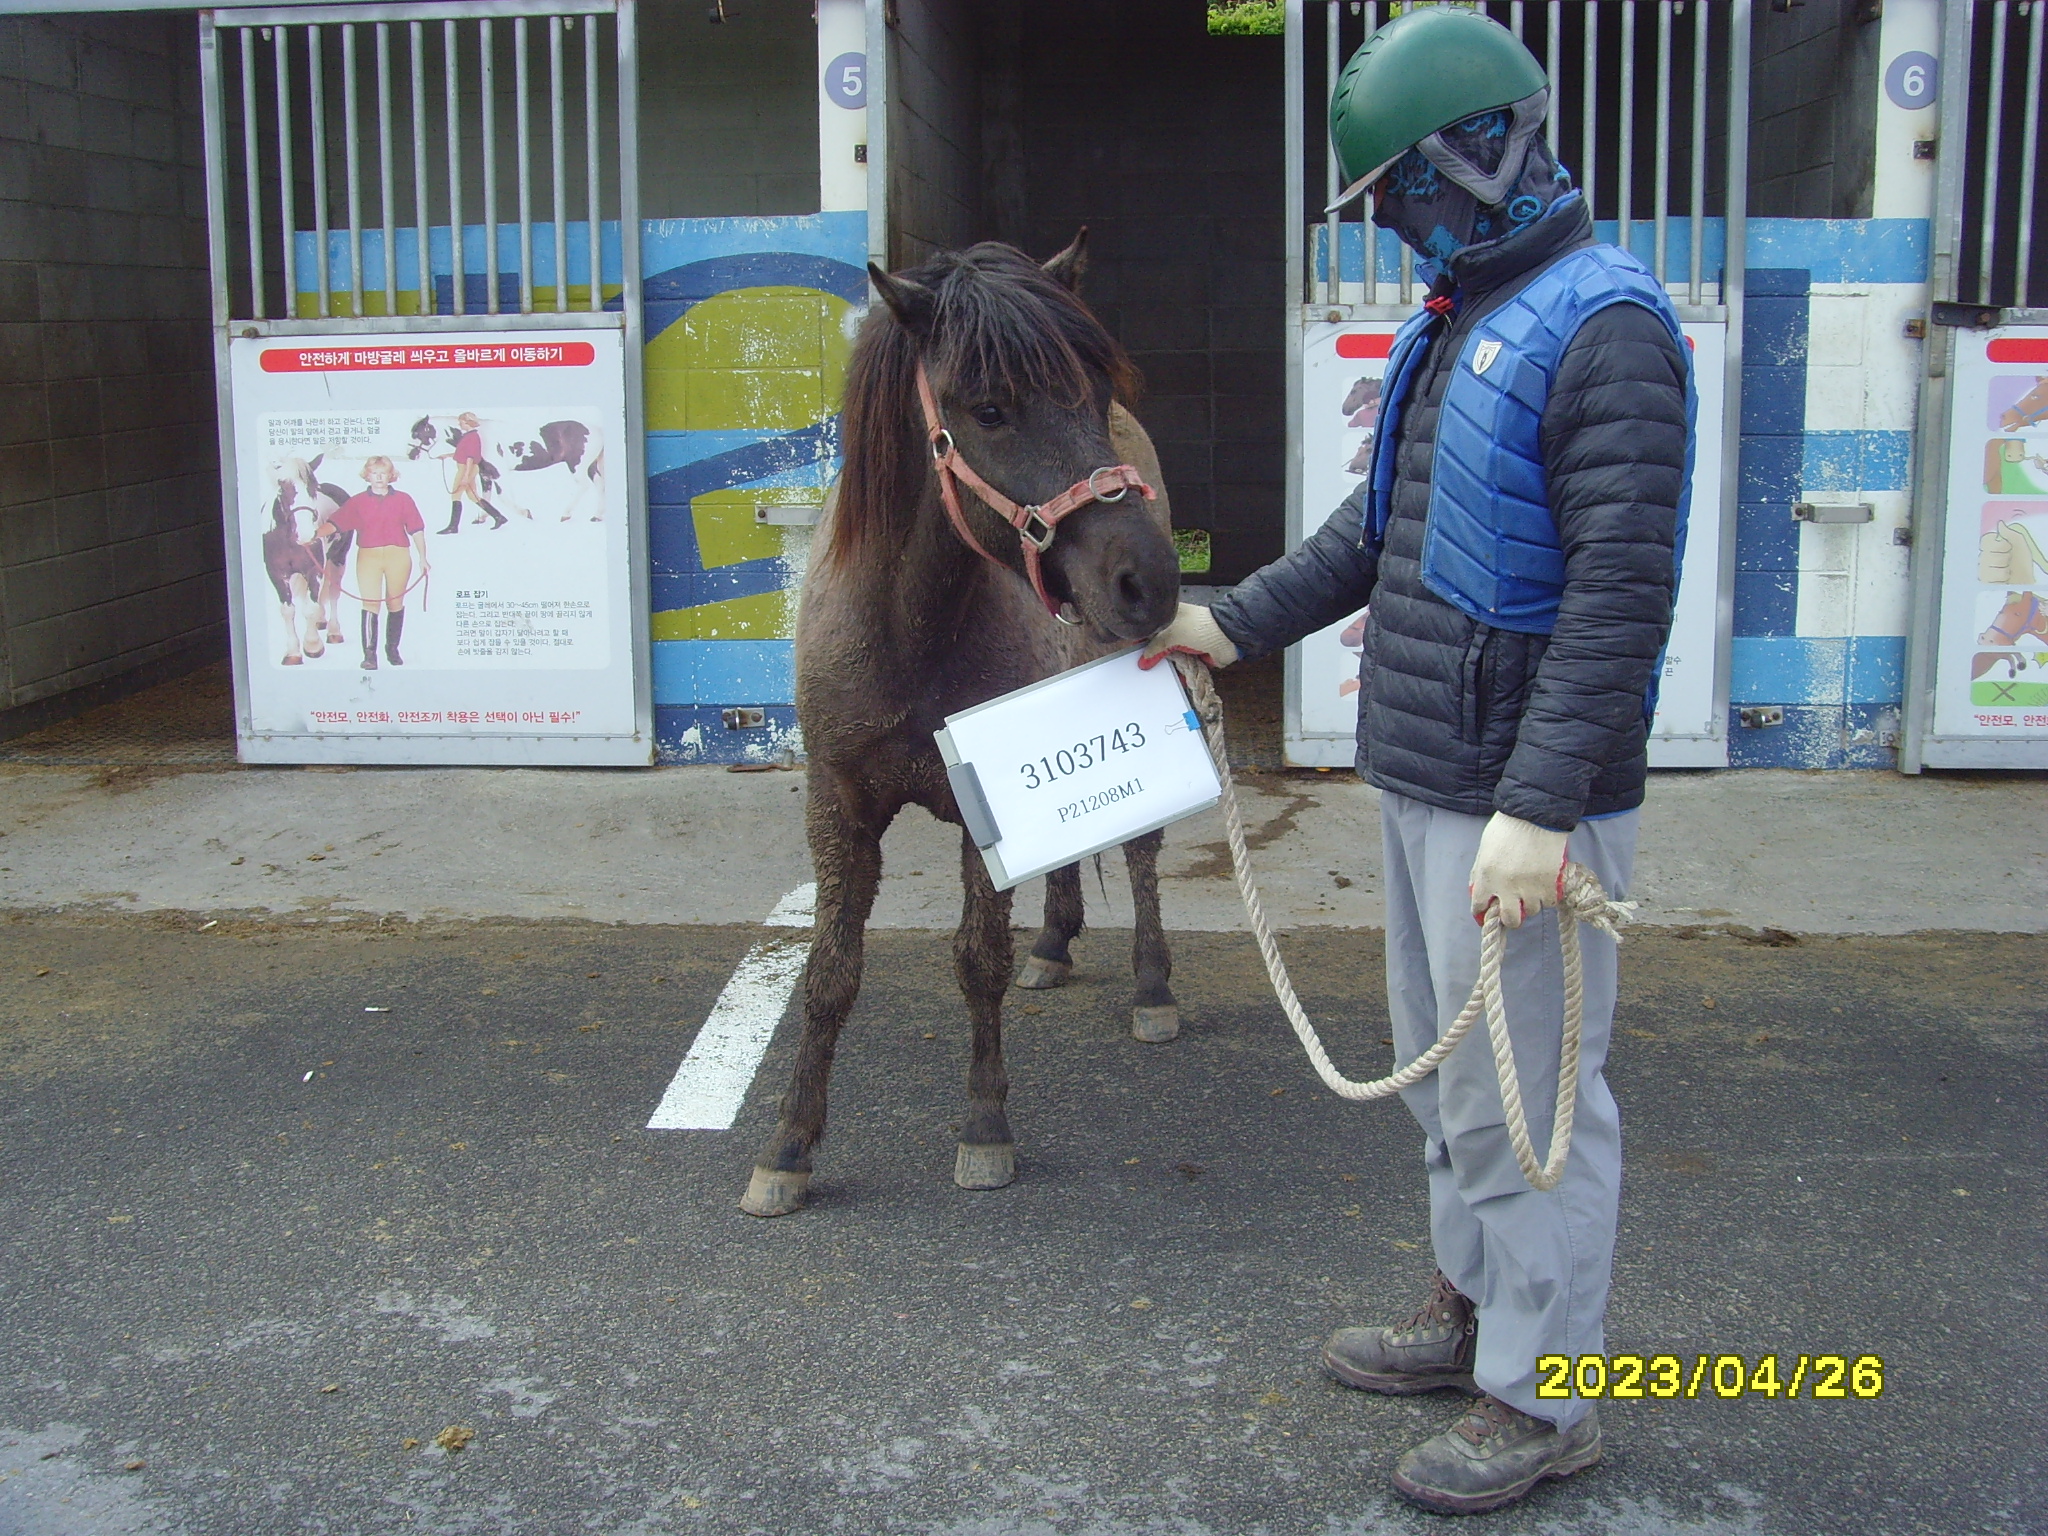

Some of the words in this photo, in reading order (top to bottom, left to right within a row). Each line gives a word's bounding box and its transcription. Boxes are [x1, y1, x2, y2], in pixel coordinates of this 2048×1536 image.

[842, 67, 862, 96] 5
[1903, 65, 1925, 96] 6
[299, 353, 350, 367] 안전하게
[354, 350, 405, 365] 마방굴레
[411, 349, 449, 364] 씌우고
[454, 348, 506, 363] 올바르게
[511, 347, 562, 362] 이동하기
[456, 590, 471, 598] 로프
[473, 590, 488, 598] 잡기
[356, 711, 393, 723] 안전화,
[398, 712, 442, 723] 안전조끼
[446, 711, 479, 723] 착용은
[484, 711, 517, 723] 선택이
[522, 711, 544, 723] 아닌
[2023, 715, 2048, 726] 안전
[1020, 722, 1146, 789] 3103743
[1057, 777, 1145, 824] P21208M1
